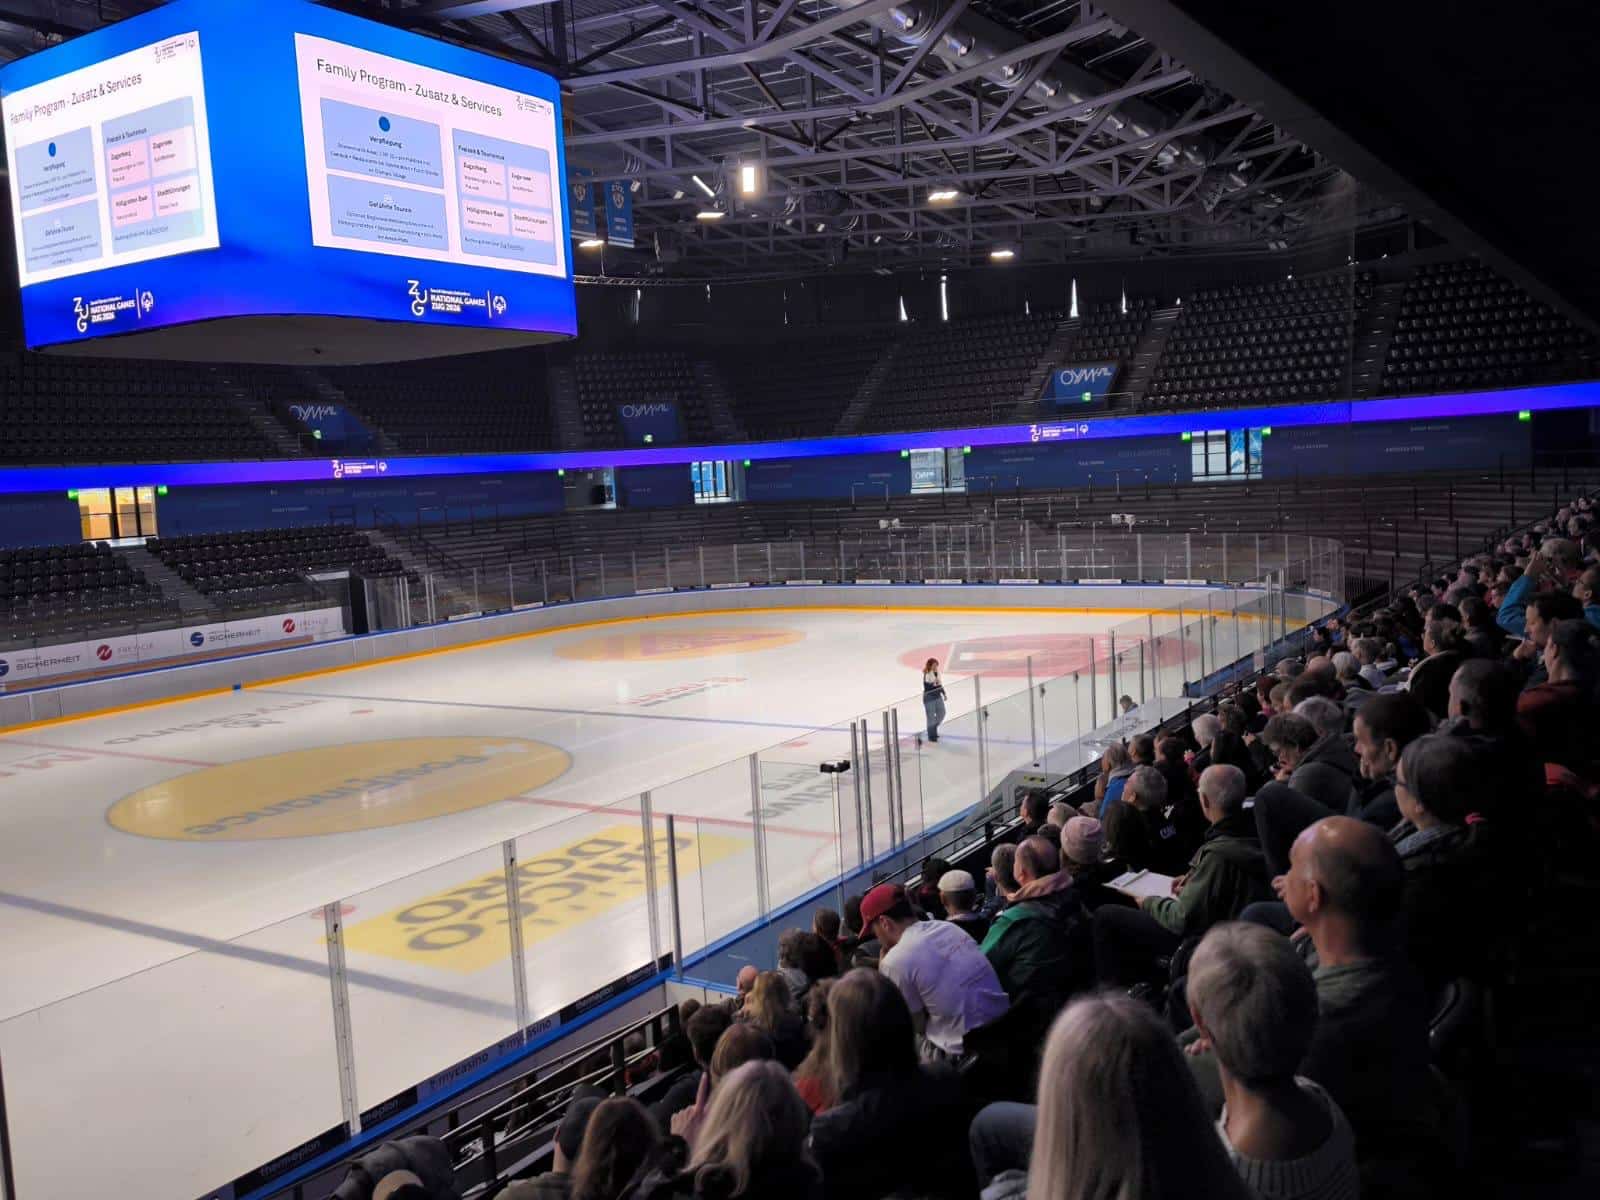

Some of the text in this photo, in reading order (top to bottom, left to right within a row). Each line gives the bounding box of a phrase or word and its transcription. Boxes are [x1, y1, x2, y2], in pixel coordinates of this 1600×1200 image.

[34, 99, 66, 116] Program
[71, 88, 98, 105] Zusatz
[99, 83, 105, 96] &
[106, 73, 142, 93] Services
[316, 58, 357, 82] Family
[359, 69, 407, 92] Program
[415, 84, 450, 103] Zusatz
[451, 93, 459, 105] &
[461, 95, 502, 116] Services
[430, 294, 486, 307] NATIONAL GAMES
[16, 655, 80, 671] SICHERHEIT
